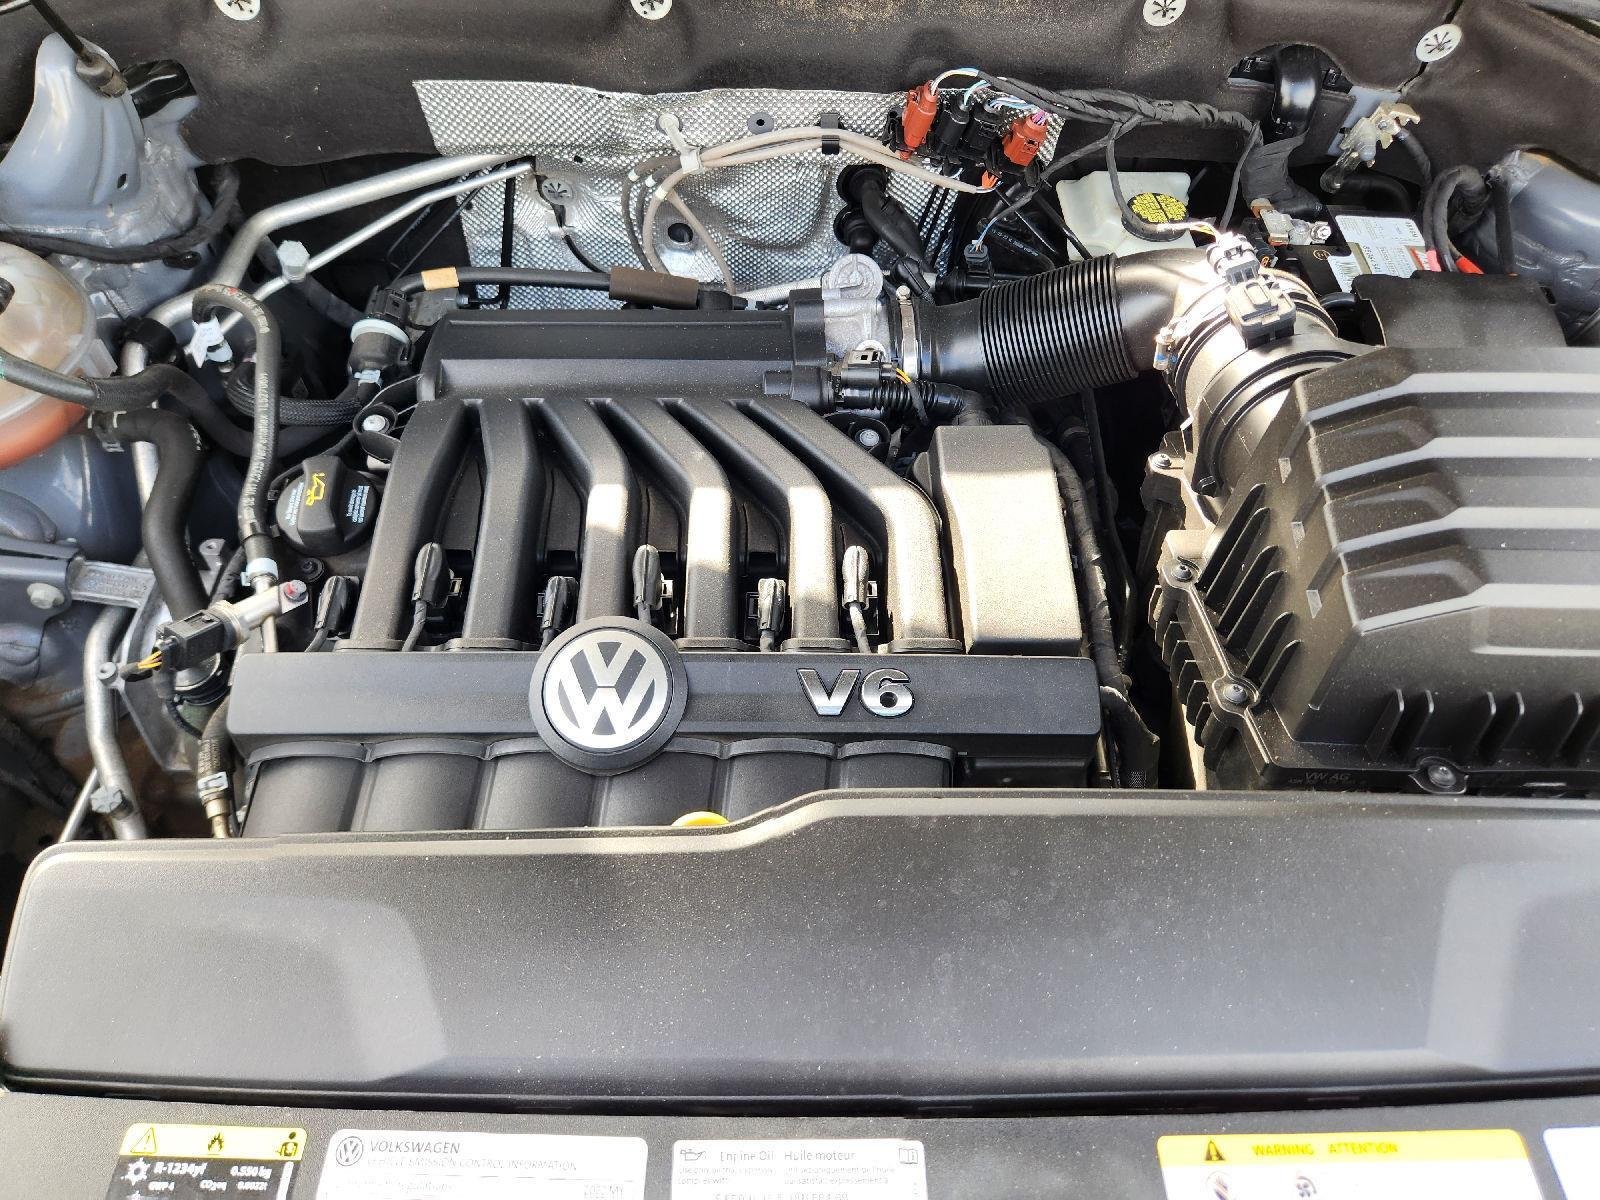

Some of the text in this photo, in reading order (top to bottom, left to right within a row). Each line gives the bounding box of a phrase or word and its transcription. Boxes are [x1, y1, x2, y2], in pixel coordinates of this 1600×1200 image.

[796, 668, 915, 718] V6
[370, 1140, 461, 1154] VOLKSWAGEN
[1252, 1141, 1398, 1156] WARNING ATTENTION
[759, 1149, 774, 1161] Oil
[784, 1148, 856, 1161] Huile moteur
[153, 1161, 208, 1178] R-1234yf
